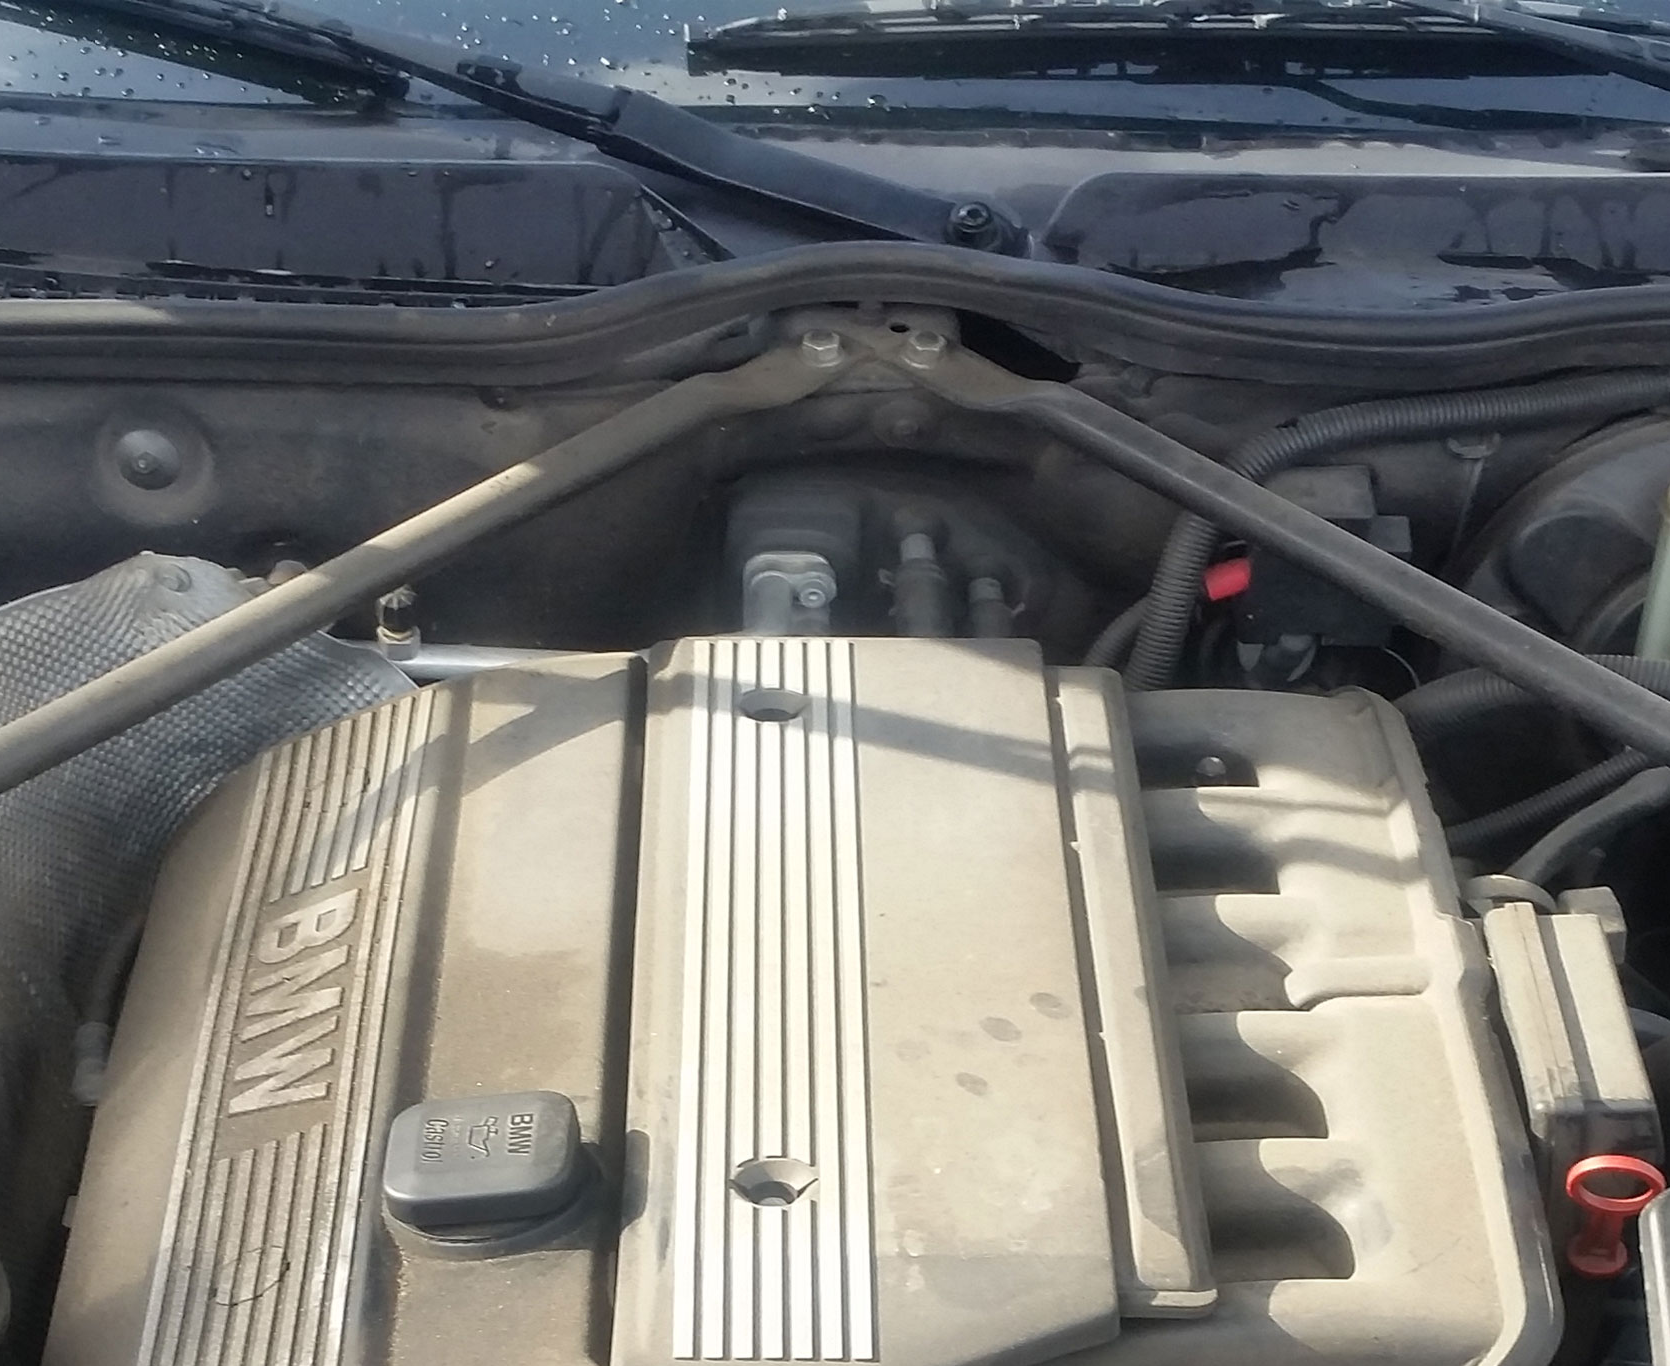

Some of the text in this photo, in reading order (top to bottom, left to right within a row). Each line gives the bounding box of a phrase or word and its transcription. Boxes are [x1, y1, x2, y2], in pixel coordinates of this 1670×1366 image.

[228, 887, 361, 1117] BMW
[420, 1117, 449, 1164] Castrol
[507, 1112, 533, 1155] BMW
